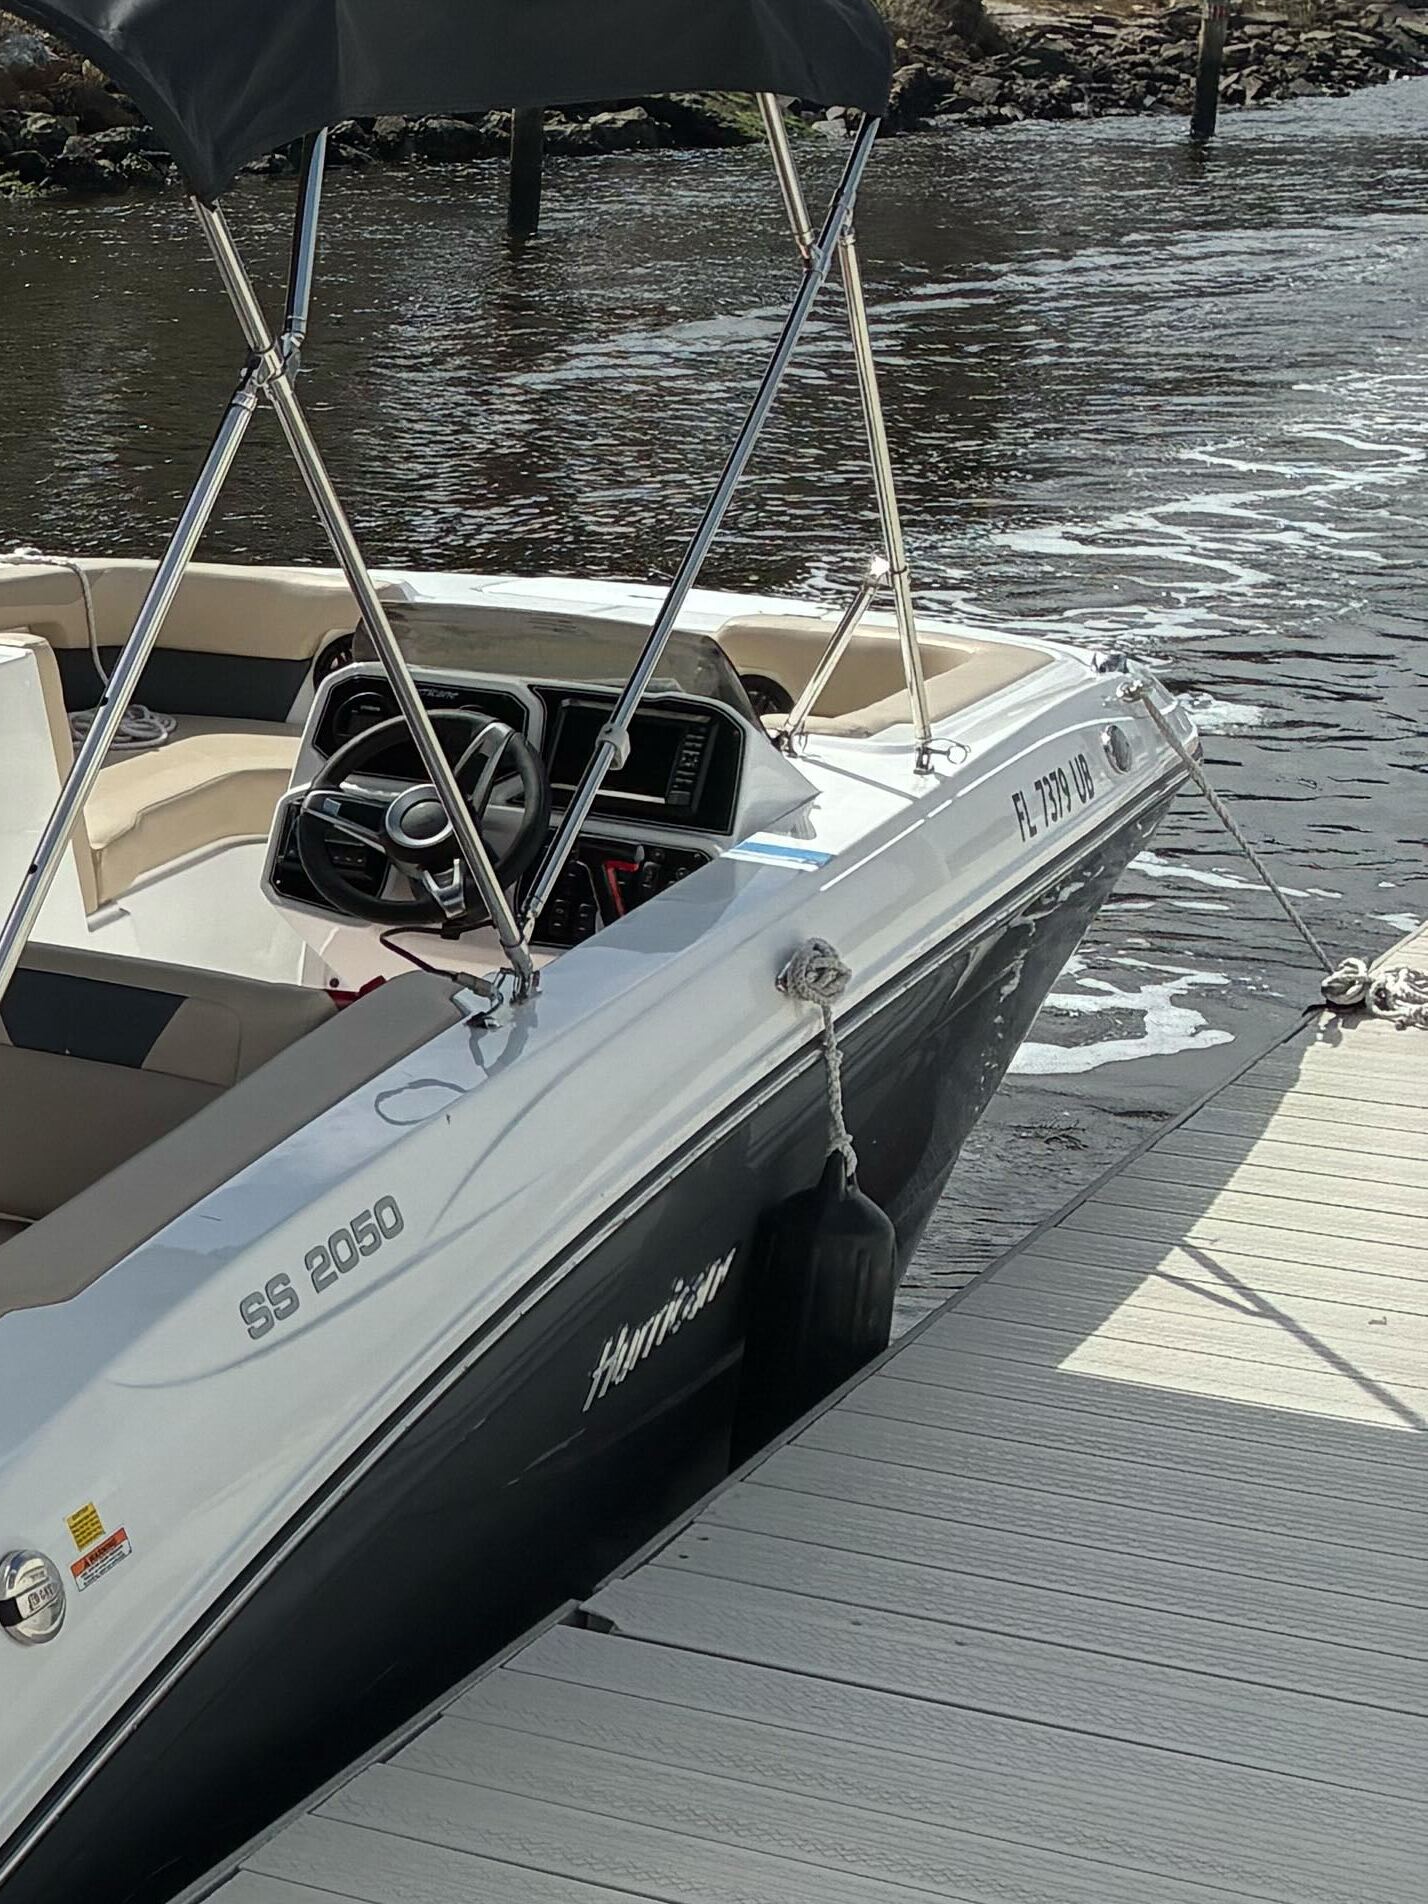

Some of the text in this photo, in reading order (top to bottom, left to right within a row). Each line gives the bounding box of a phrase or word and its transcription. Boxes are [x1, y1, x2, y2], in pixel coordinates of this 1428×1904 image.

[1011, 753, 1095, 842] FL 7379 UB
[239, 1195, 404, 1340] SS 2050
